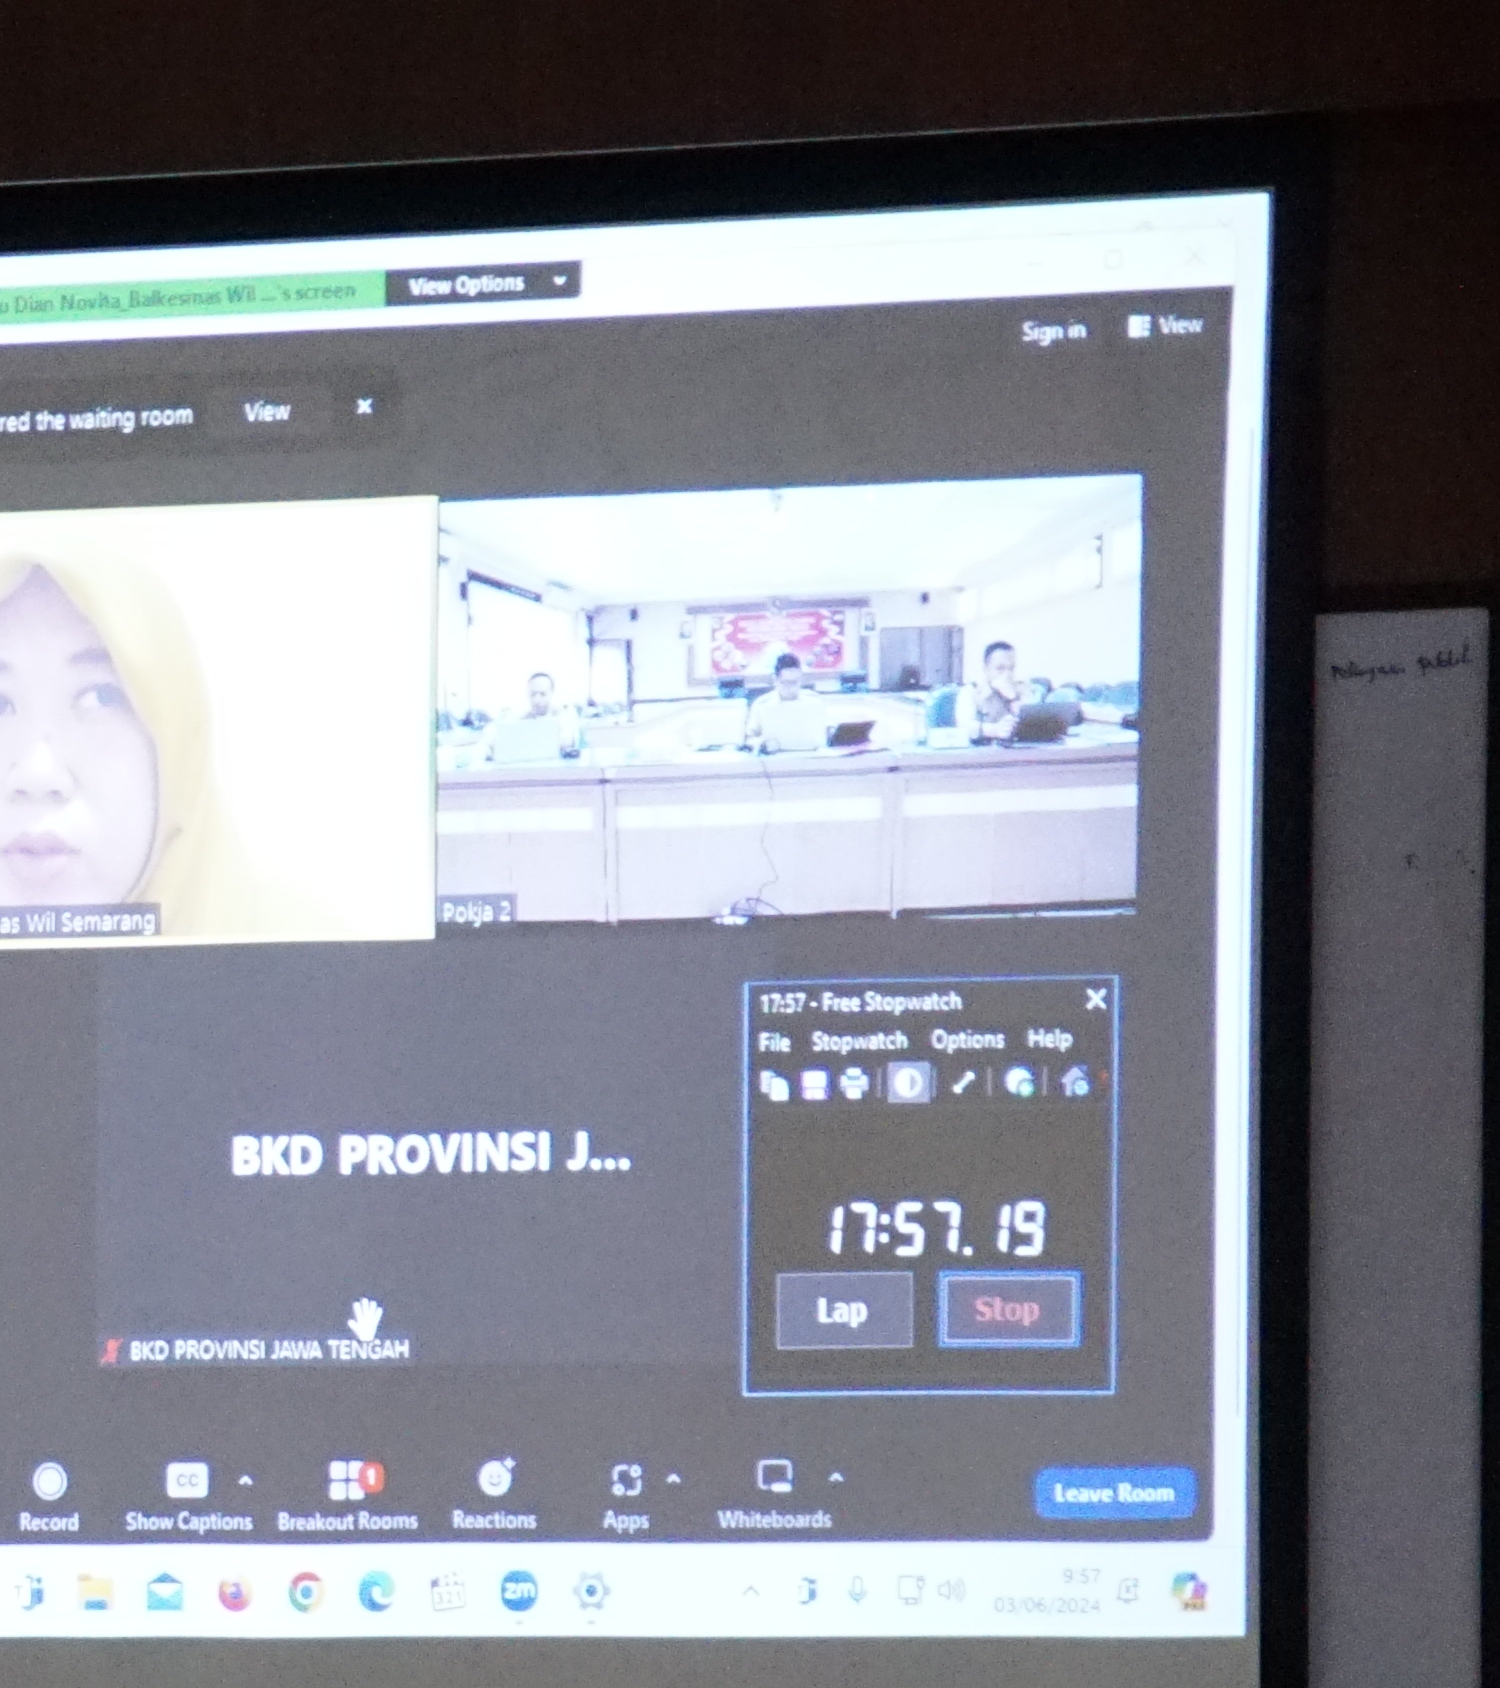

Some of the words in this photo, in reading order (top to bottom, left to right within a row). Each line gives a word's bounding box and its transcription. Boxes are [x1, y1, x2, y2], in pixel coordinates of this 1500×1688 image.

[408, 277, 453, 296] View
[455, 274, 525, 296] Options
[14, 294, 54, 314] Dian
[295, 284, 357, 301] screen
[1021, 320, 1064, 346] Sign
[1067, 318, 1087, 339] in
[1158, 315, 1204, 335] View
[35, 409, 66, 431] the
[68, 406, 137, 433] waiting
[140, 407, 194, 427] room
[244, 400, 292, 423] View
[25, 912, 56, 933] Wil
[60, 911, 156, 936] Semarang
[442, 902, 494, 926] Pokja
[498, 901, 513, 921] 2
[759, 992, 807, 1014] 17:57
[822, 992, 862, 1013] Free
[864, 990, 963, 1015] Stopwatch
[758, 1032, 792, 1053] File
[811, 1030, 909, 1055] Stopwatch
[930, 1027, 1006, 1051] Options
[1027, 1028, 1074, 1052] Help
[230, 1133, 324, 1177] BKD
[338, 1130, 551, 1176] PROVINSI
[816, 1296, 869, 1328] Lap
[974, 1296, 1040, 1327] Stop
[129, 1340, 170, 1362] BKD
[174, 1339, 267, 1361] PROVINSI
[270, 1339, 323, 1361] JAWA
[327, 1338, 411, 1361] TENGAH
[1053, 1483, 1113, 1503] Leave
[1116, 1483, 1176, 1505] Room
[18, 1511, 80, 1532] Record
[125, 1511, 175, 1532] Show
[177, 1511, 253, 1535] Captions
[277, 1511, 355, 1531] Breakout
[358, 1510, 419, 1530] Rooms
[451, 1509, 538, 1530] Reactions
[603, 1510, 650, 1533] Apps
[717, 1509, 833, 1530] Whiteboards
